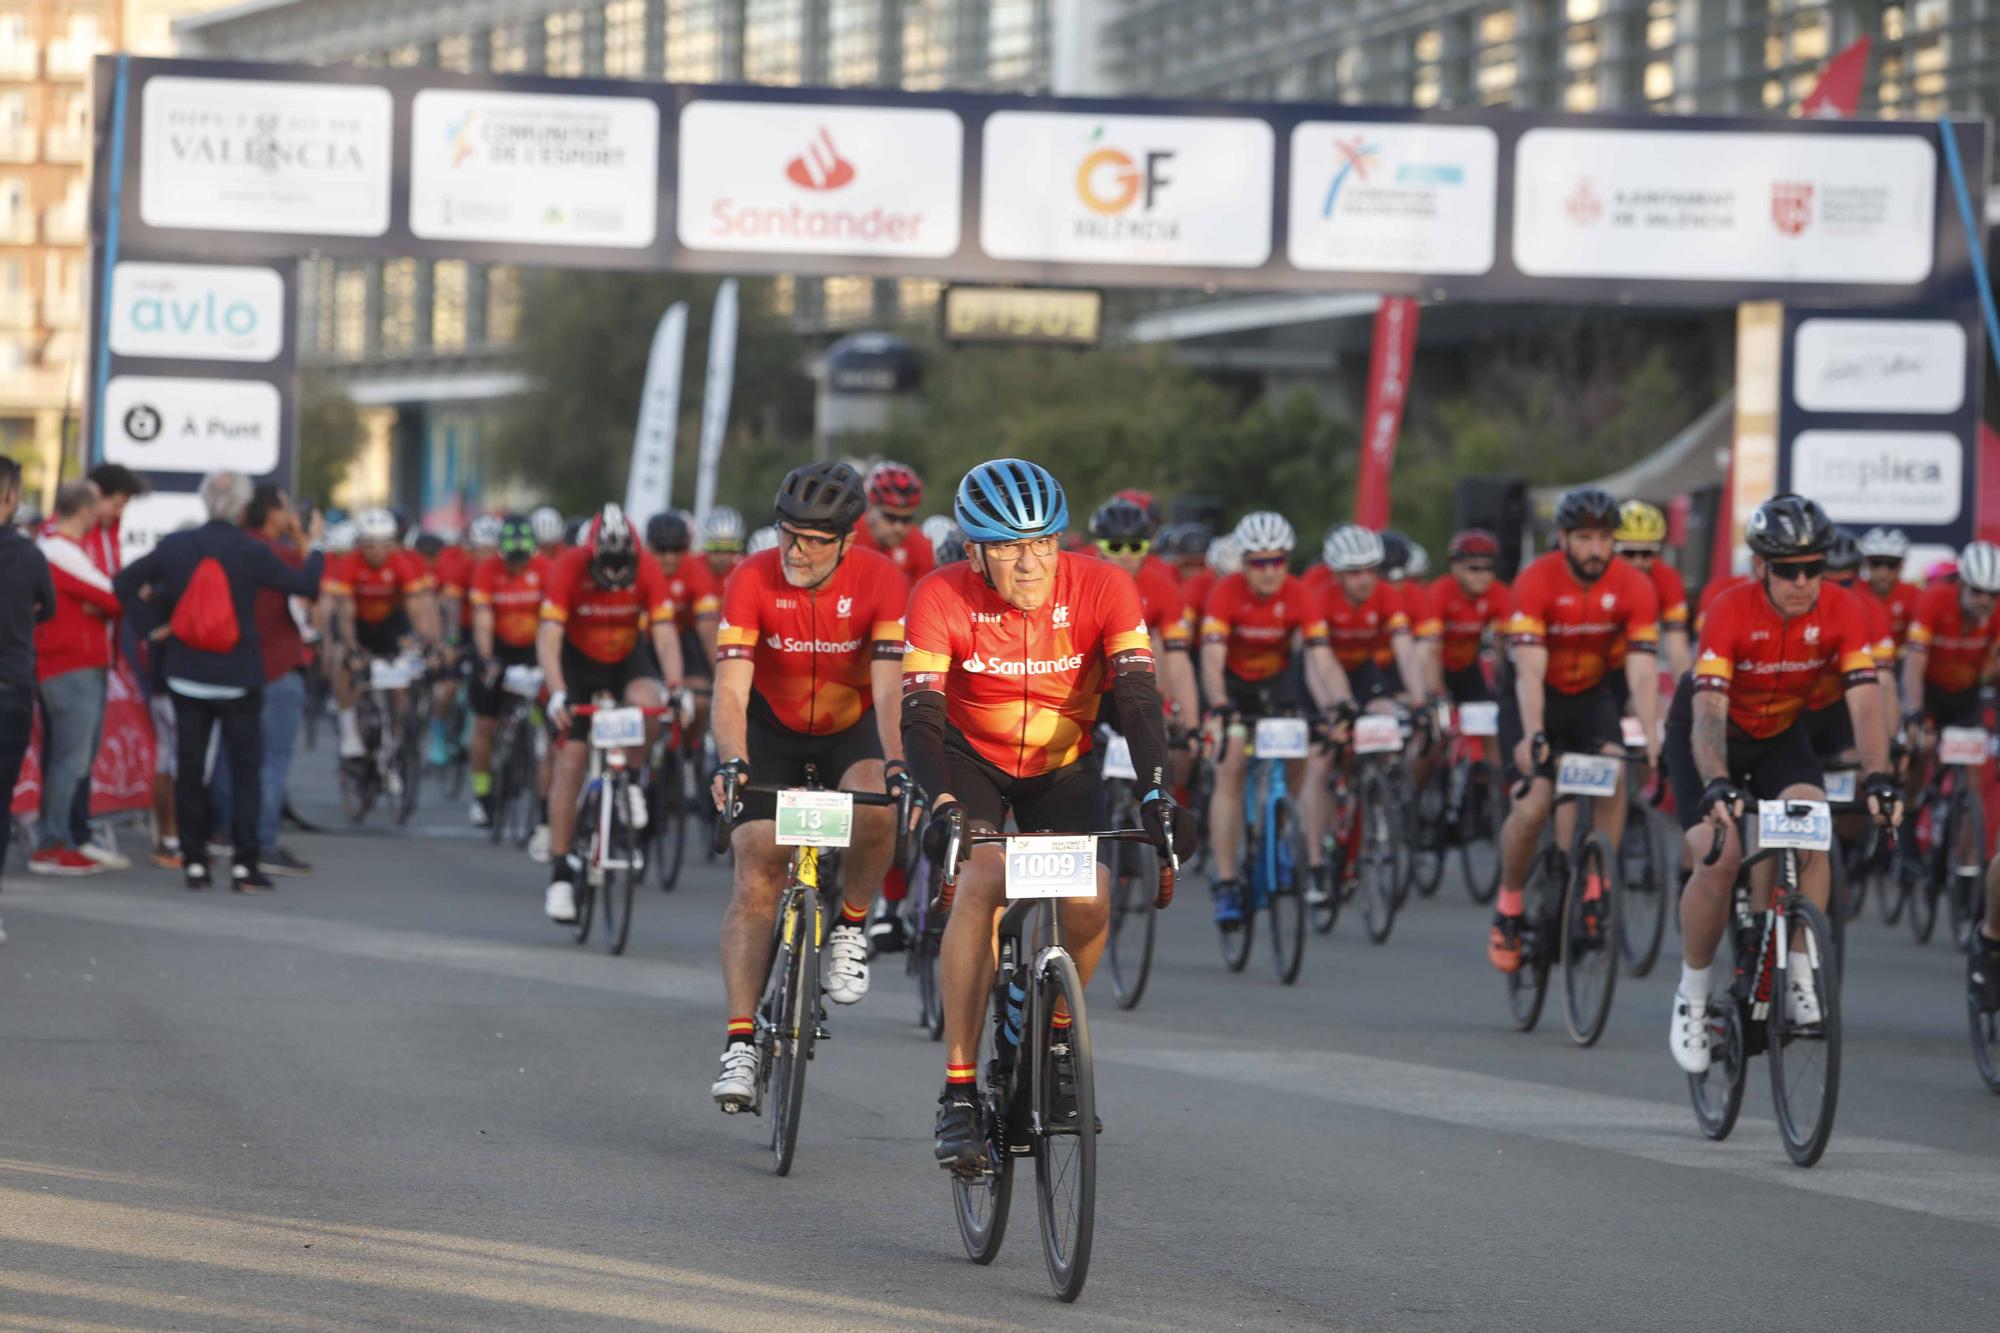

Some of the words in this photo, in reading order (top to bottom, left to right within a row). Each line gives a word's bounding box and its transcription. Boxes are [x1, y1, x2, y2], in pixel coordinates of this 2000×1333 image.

[1076, 147, 1176, 216] GF
[712, 197, 923, 243] Santander
[130, 287, 259, 336] avlo
[206, 417, 262, 439] Punt
[783, 637, 863, 654] Santander
[987, 653, 1085, 676] Santander
[796, 810, 824, 831] 13
[1767, 814, 1815, 834] 1263
[1014, 854, 1076, 878] 1009
